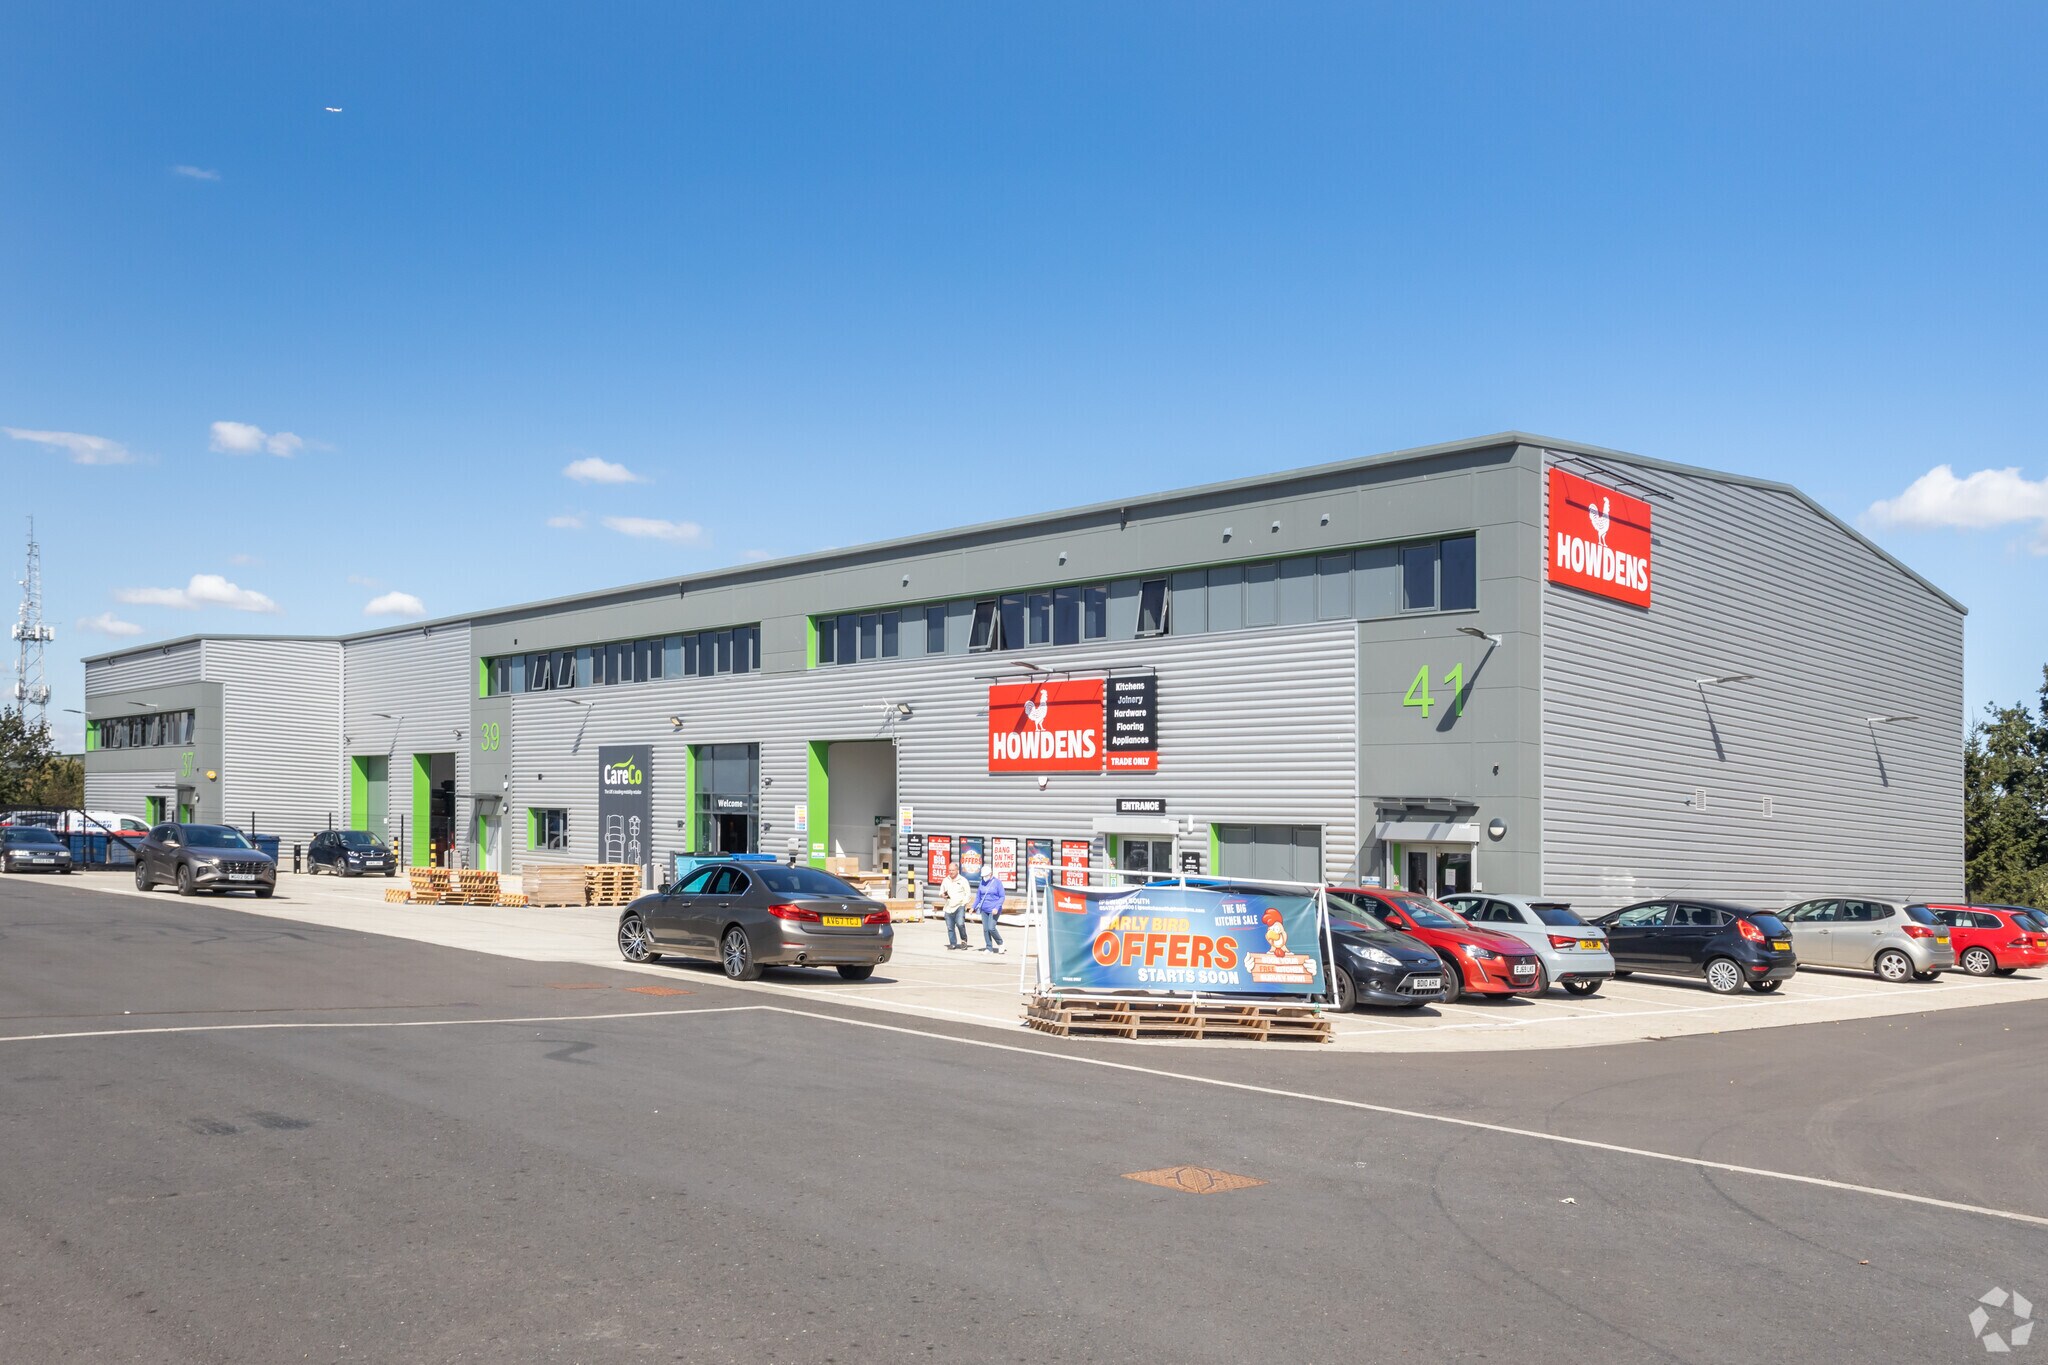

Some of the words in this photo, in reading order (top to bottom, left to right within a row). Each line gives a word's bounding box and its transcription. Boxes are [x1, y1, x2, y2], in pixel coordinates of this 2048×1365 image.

[1557, 532, 1648, 592] HOWDENS
[1115, 682, 1145, 691] Kitchens
[1403, 662, 1463, 718] 41
[1118, 695, 1143, 704] Joinery
[1114, 709, 1147, 718] Hardware
[1116, 722, 1144, 732] Flooring
[481, 722, 500, 751] 39
[1112, 735, 1149, 745] Appliances
[993, 729, 1096, 760] HOWDENS
[181, 751, 195, 777] 37
[1111, 757, 1133, 766] TRADE
[1133, 757, 1150, 766] ONLY
[604, 764, 642, 785] CareCo
[718, 799, 743, 808] Welcome
[1121, 801, 1160, 811] ENTRANCE
[994, 846, 1010, 854] BANG
[933, 855, 946, 864] BIG
[960, 857, 983, 865] OFFERS
[932, 869, 947, 877] SALE
[1066, 877, 1084, 886] SALE
[1222, 904, 1235, 914] THE
[1235, 903, 1247, 914] BIG
[1151, 917, 1190, 932] BIRD
[1214, 915, 1242, 927] KITCHEN
[1242, 915, 1258, 925] SALE
[1092, 931, 1239, 970] OFFERS
[1137, 967, 1196, 983] STARTS
[1198, 969, 1239, 985] SOON
